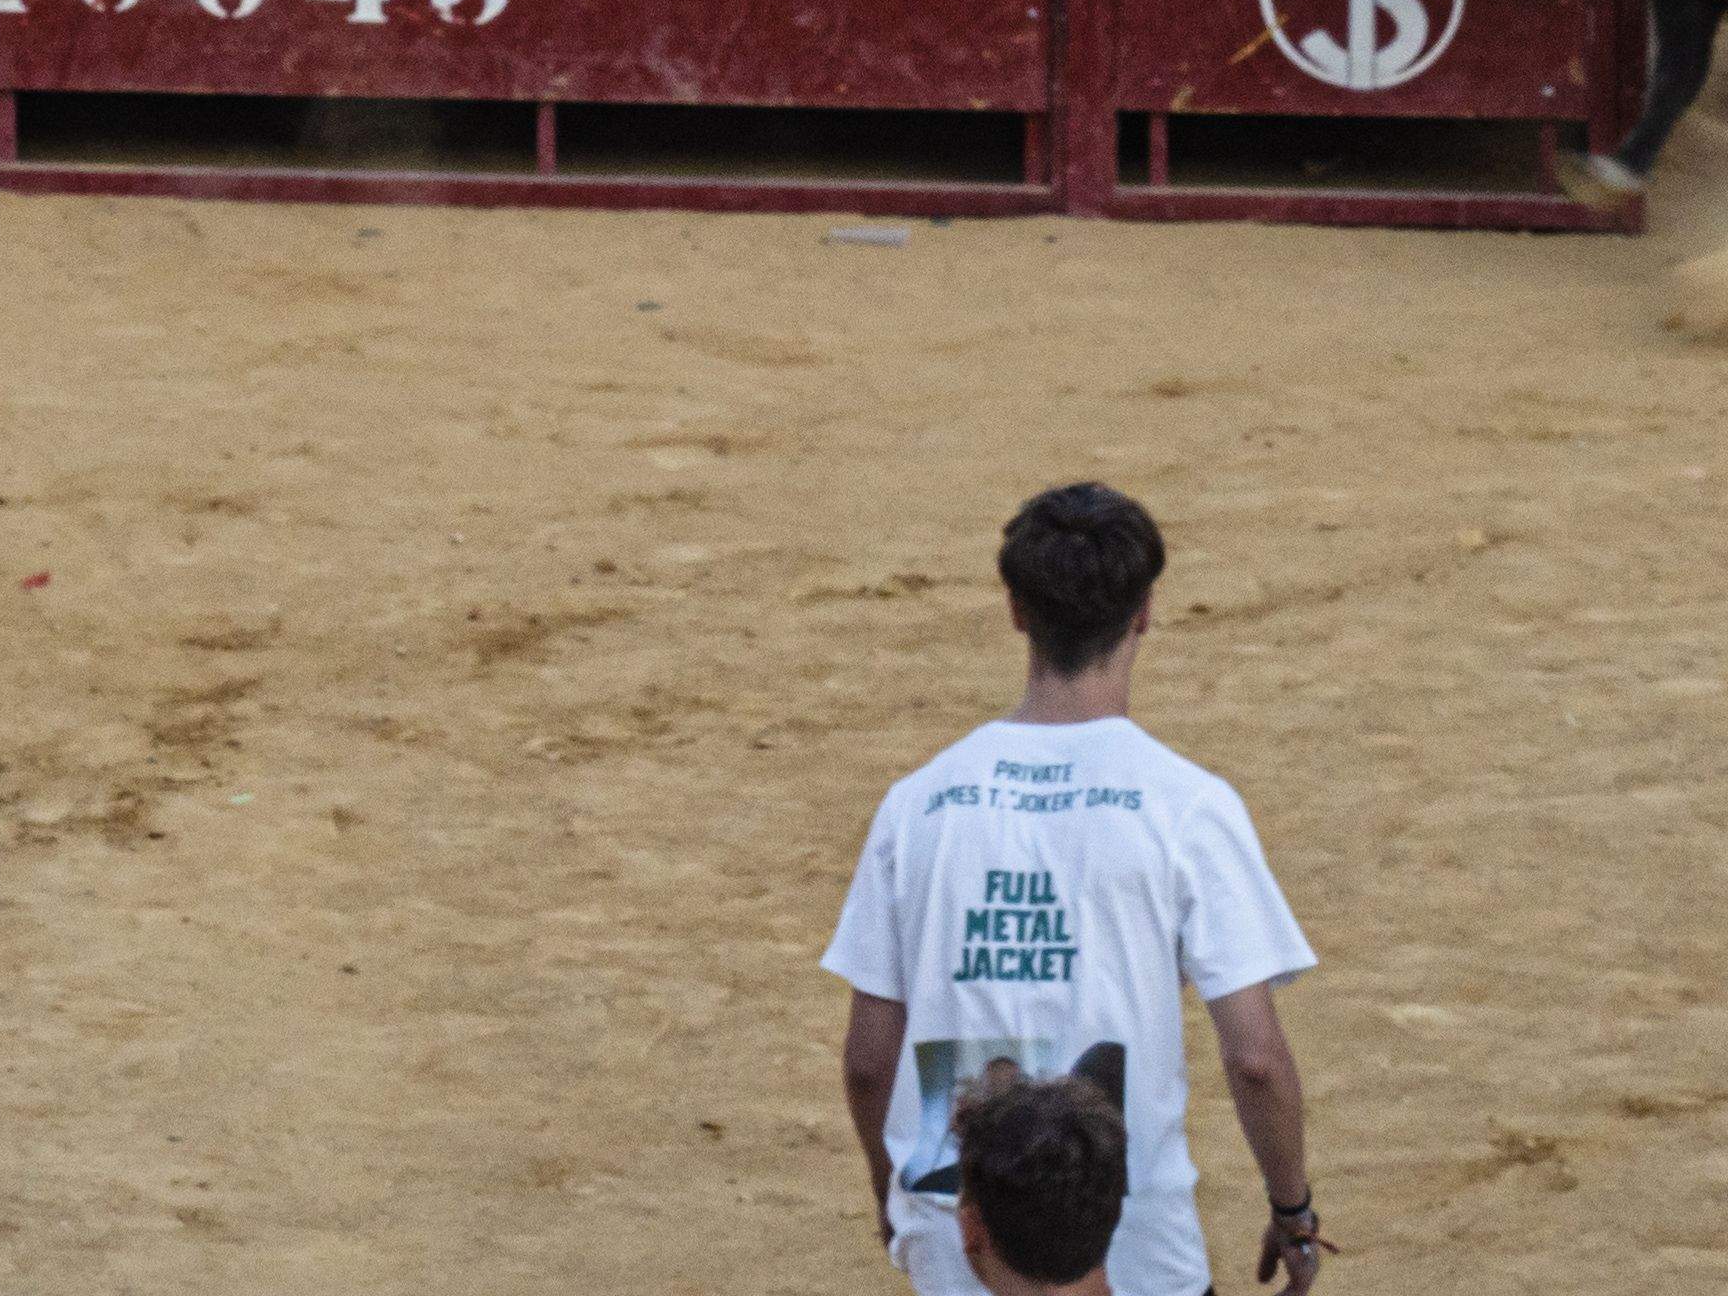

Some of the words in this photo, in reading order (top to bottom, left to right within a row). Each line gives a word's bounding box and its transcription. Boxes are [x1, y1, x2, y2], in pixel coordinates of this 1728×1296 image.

[993, 759, 1075, 784] PRIVATE
[924, 784, 980, 816] JAMES
[1085, 787, 1142, 811] DAVIS
[984, 870, 1057, 904] FULL
[965, 908, 1071, 942] METAL
[952, 946, 1079, 982] JACKET
